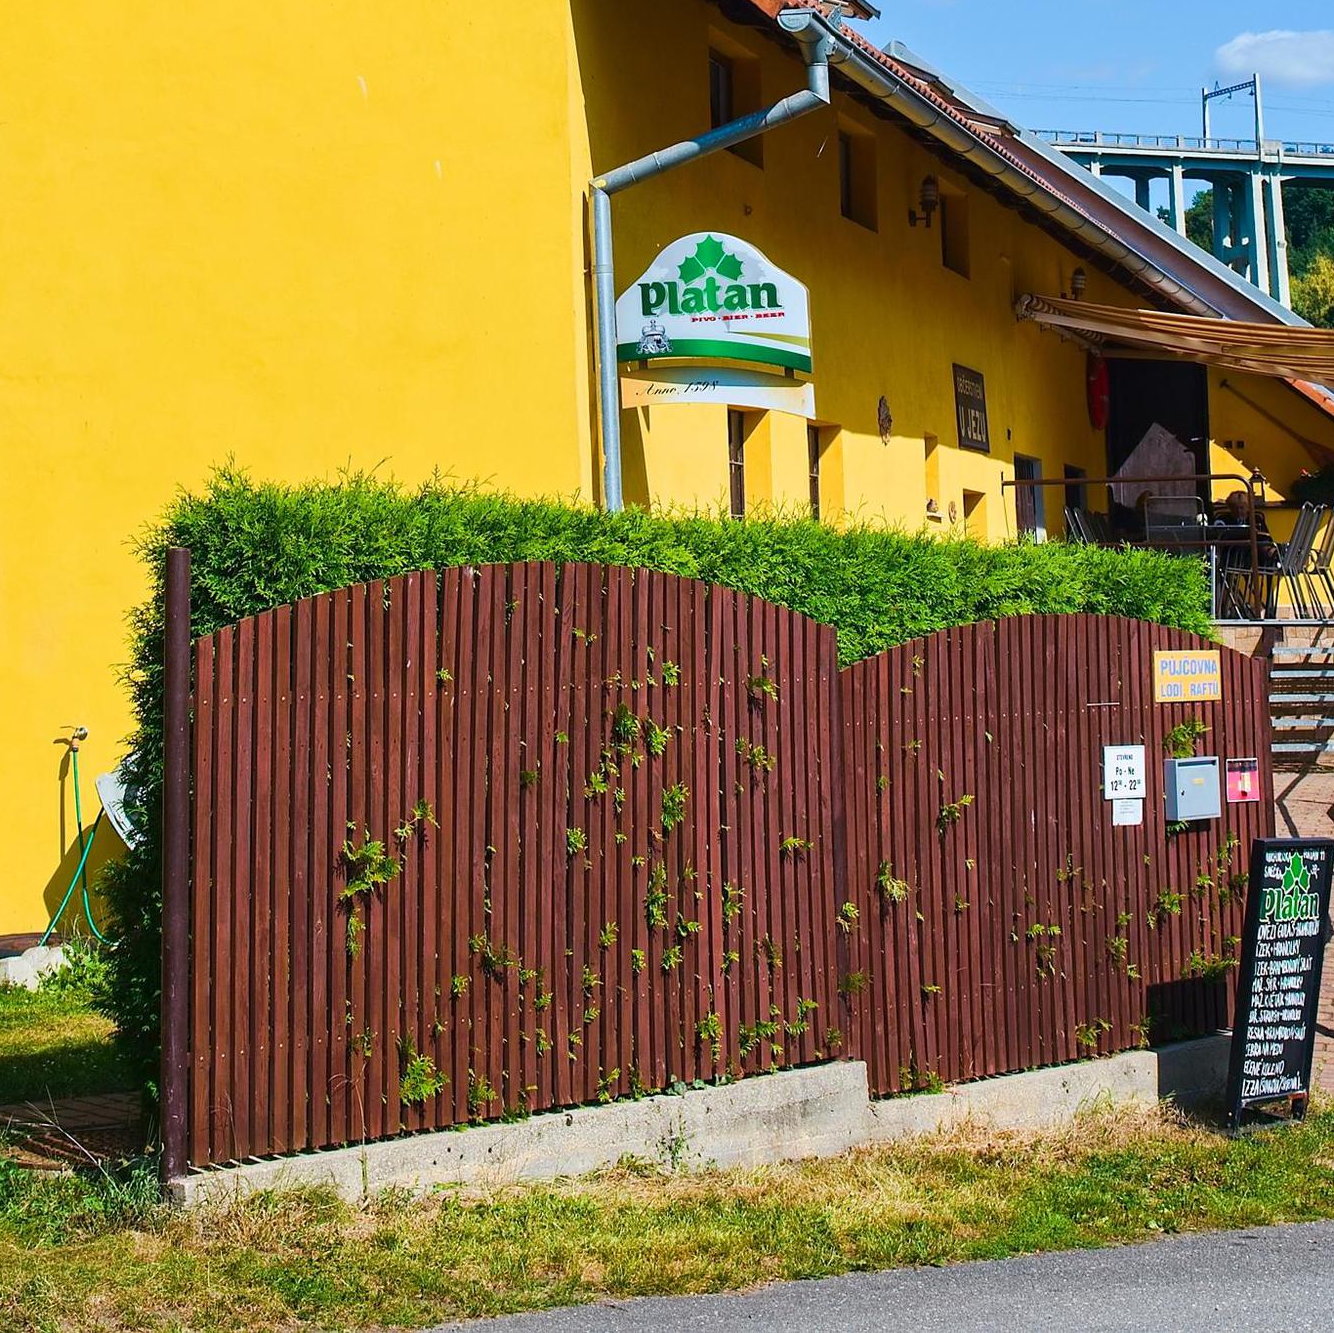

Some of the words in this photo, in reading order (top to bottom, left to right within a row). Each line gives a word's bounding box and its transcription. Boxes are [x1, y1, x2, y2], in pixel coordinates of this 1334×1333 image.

[683, 380, 719, 393] 1598
[958, 405, 966, 437] U
[967, 408, 986, 443] JEZU
[1116, 767, 1122, 776] Po
[1241, 1079, 1259, 1097] IZZA
